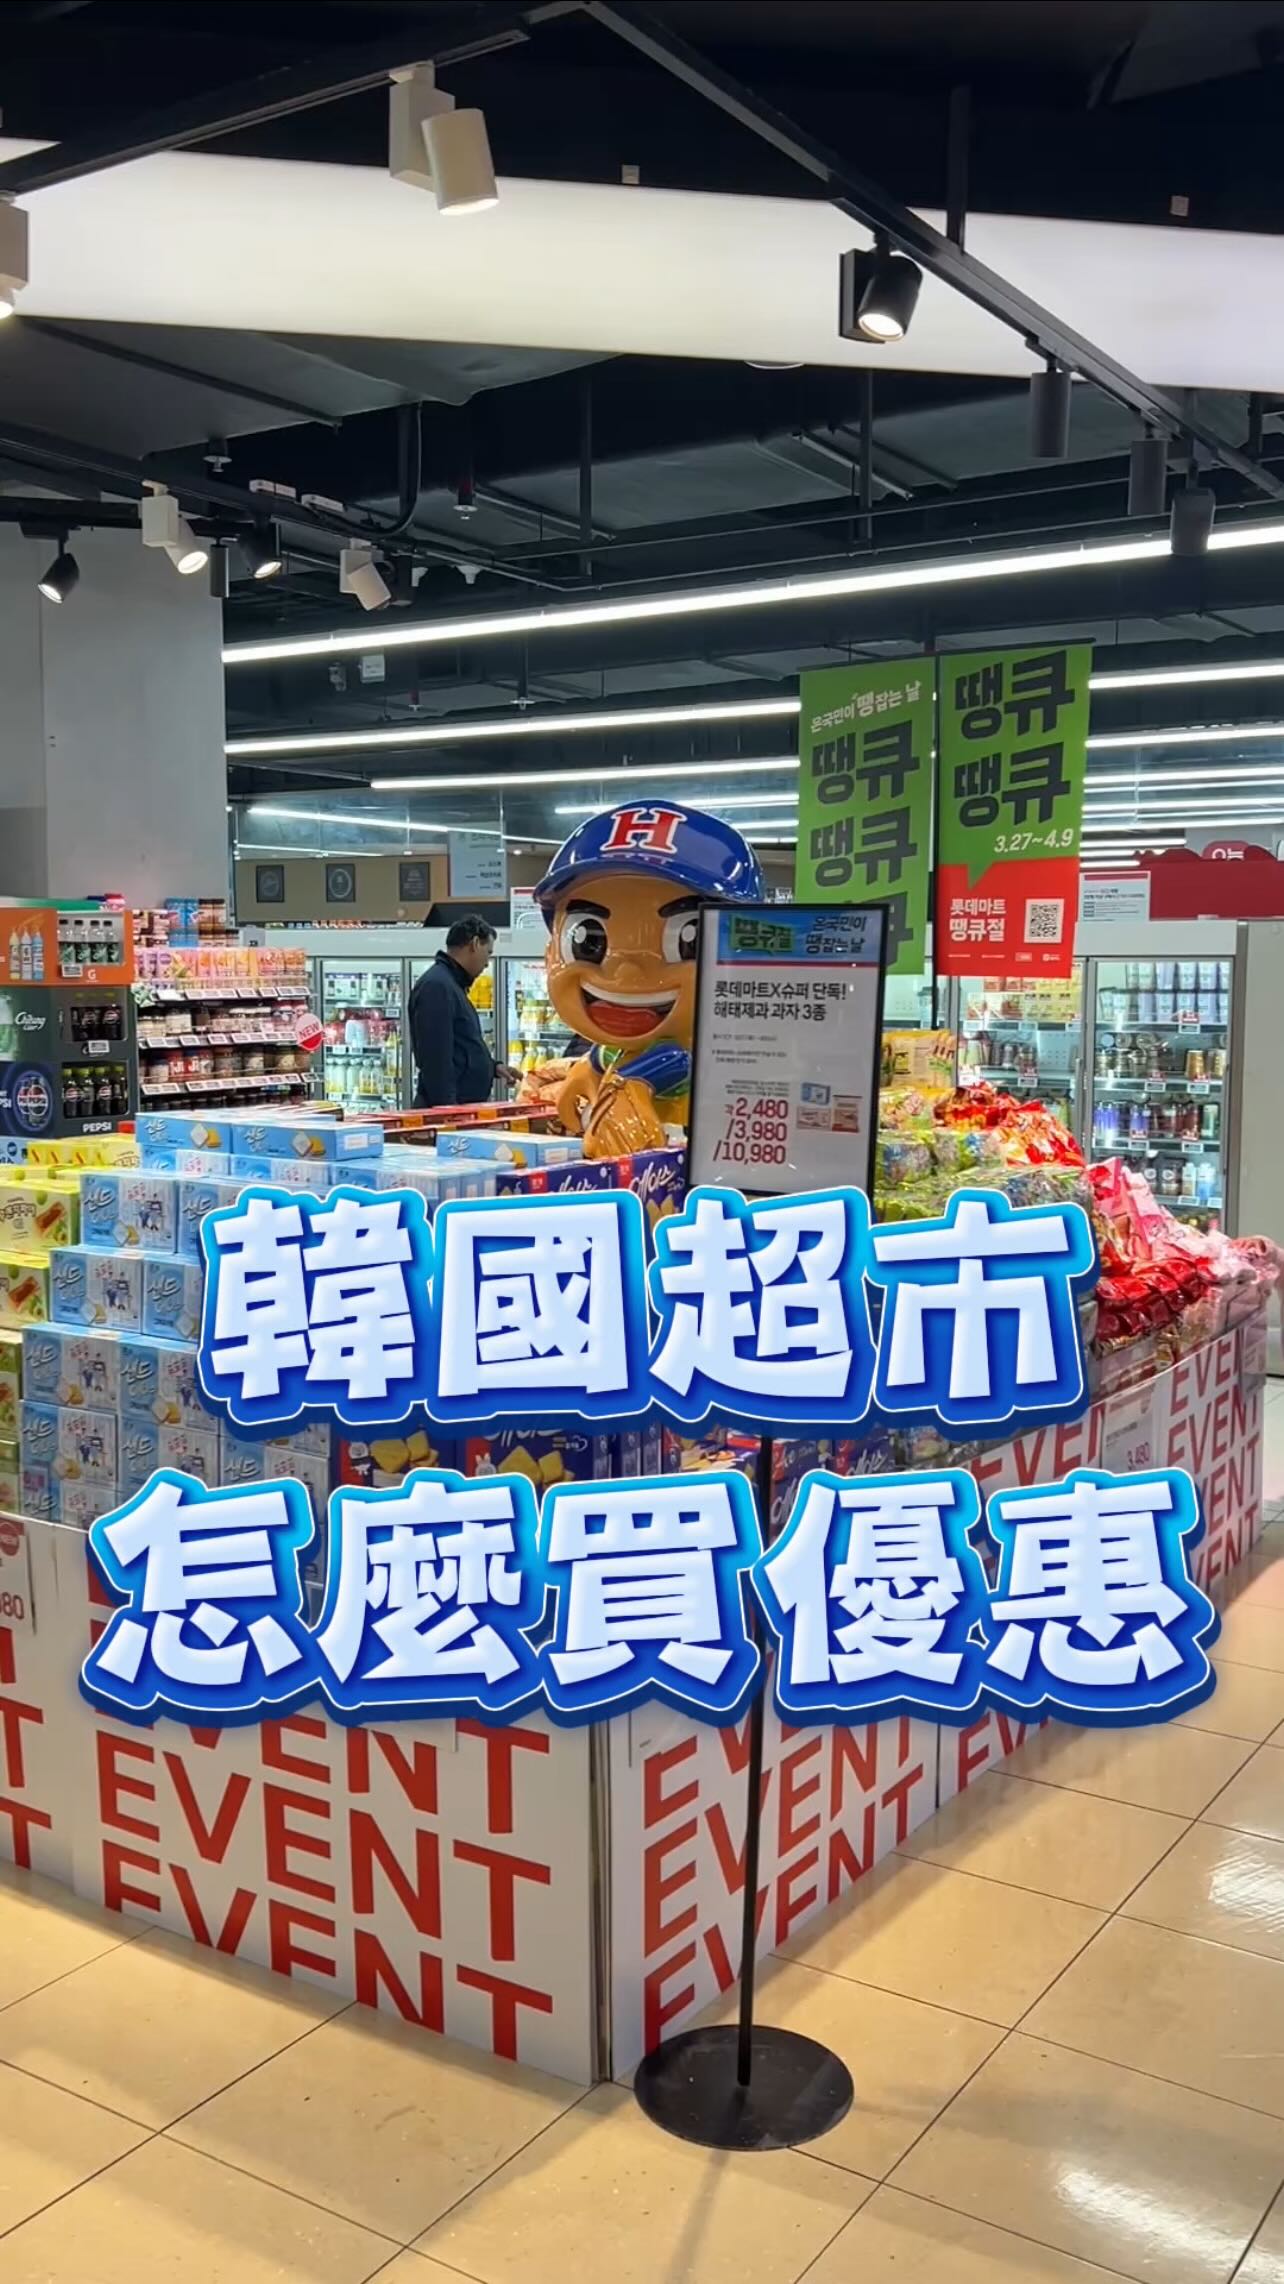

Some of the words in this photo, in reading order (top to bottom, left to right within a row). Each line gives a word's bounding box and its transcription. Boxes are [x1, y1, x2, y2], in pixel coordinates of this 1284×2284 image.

[955, 650, 1075, 740] 땡큐
[811, 720, 920, 804] 땡큐
[954, 742, 1070, 827] 땡큐
[601, 807, 688, 853] H
[994, 829, 1074, 853] 3.27~4.9
[810, 806, 918, 887] 땡큐
[950, 898, 1006, 916] 롯데마트
[814, 915, 867, 932] 온국민이
[714, 980, 810, 1001] 롯데마트X슈퍼
[812, 982, 847, 1001] 단독!
[713, 1002, 769, 1020] 해태제과
[771, 1003, 801, 1020] 과자
[802, 1003, 828, 1021] 3종
[735, 1097, 788, 1120] 2,480
[82, 1121, 112, 1134] PEPSI
[726, 1118, 788, 1143] /3,980
[713, 1140, 787, 1165] /10,980
[97, 1729, 552, 1962] EVENT
[102, 1838, 553, 2061] EVENT
